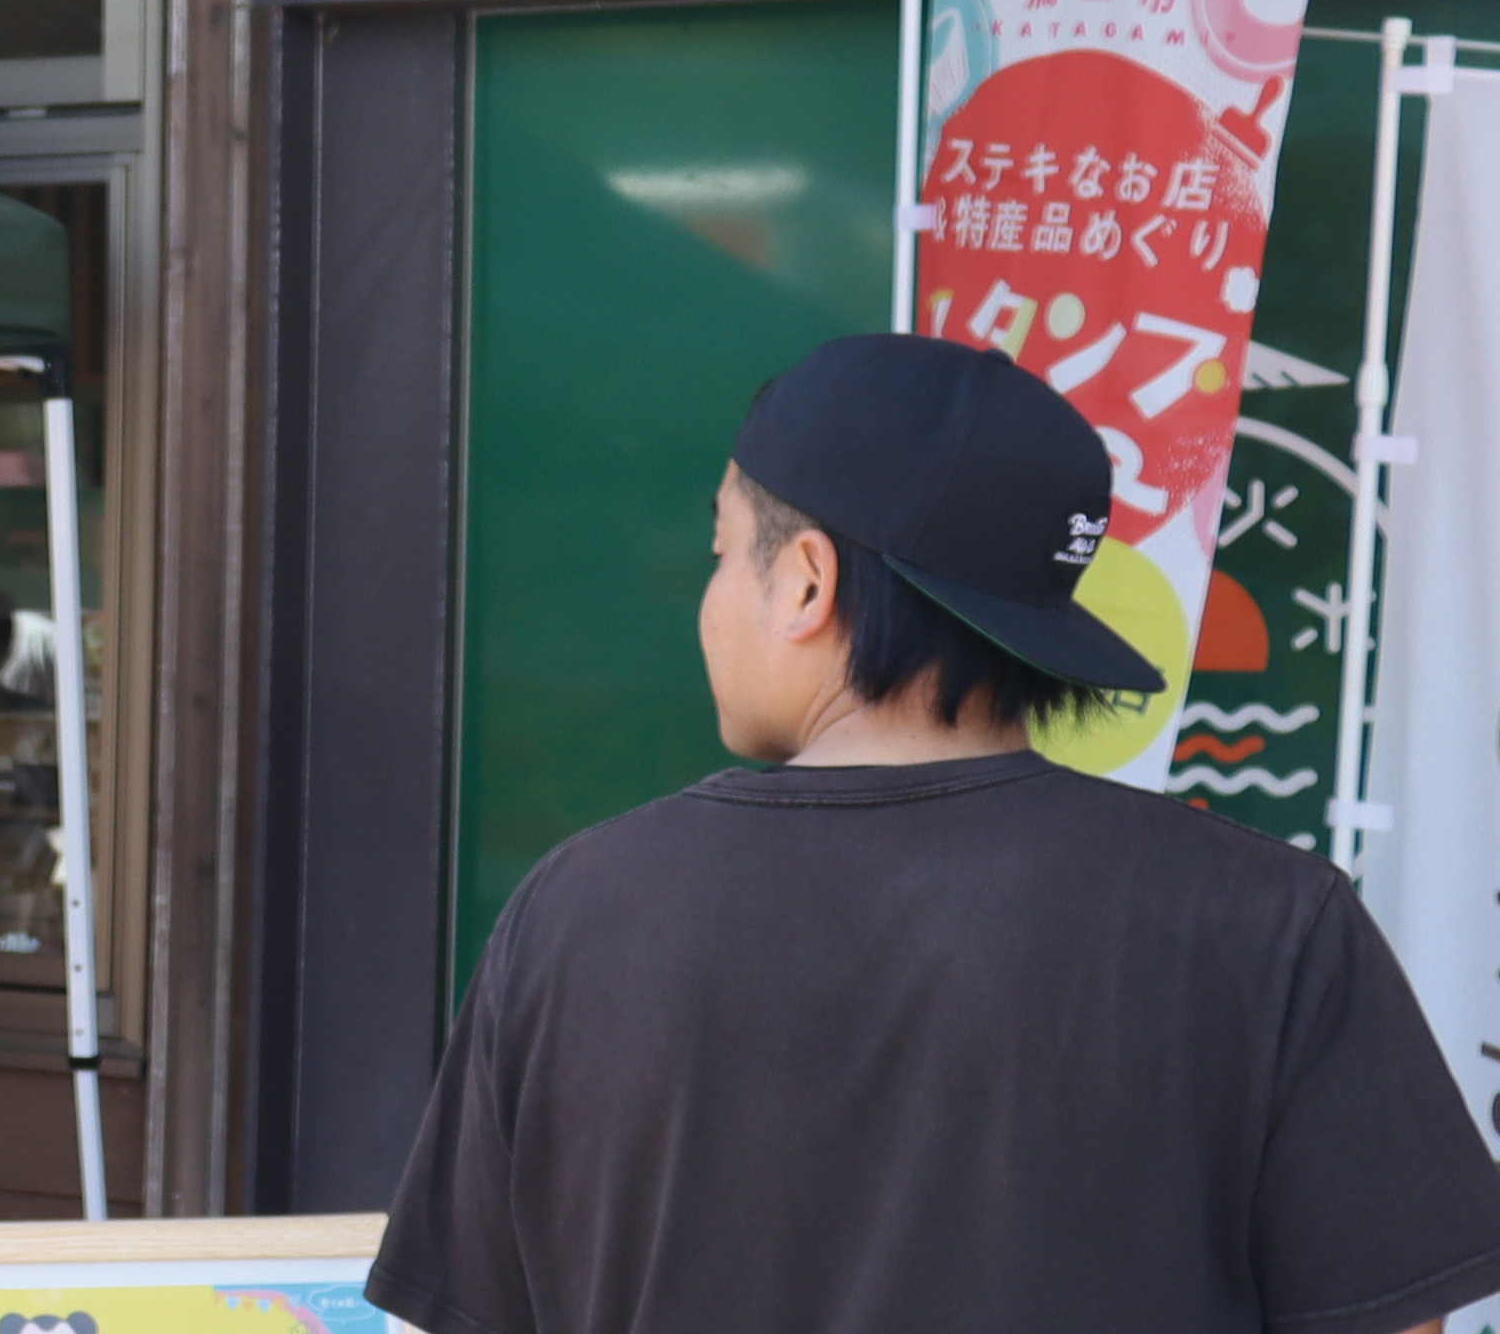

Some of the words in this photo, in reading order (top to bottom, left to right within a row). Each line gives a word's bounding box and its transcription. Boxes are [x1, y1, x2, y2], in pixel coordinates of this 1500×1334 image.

[942, 138, 1220, 210] ステキなお店
[931, 279, 1228, 419] タンプ
